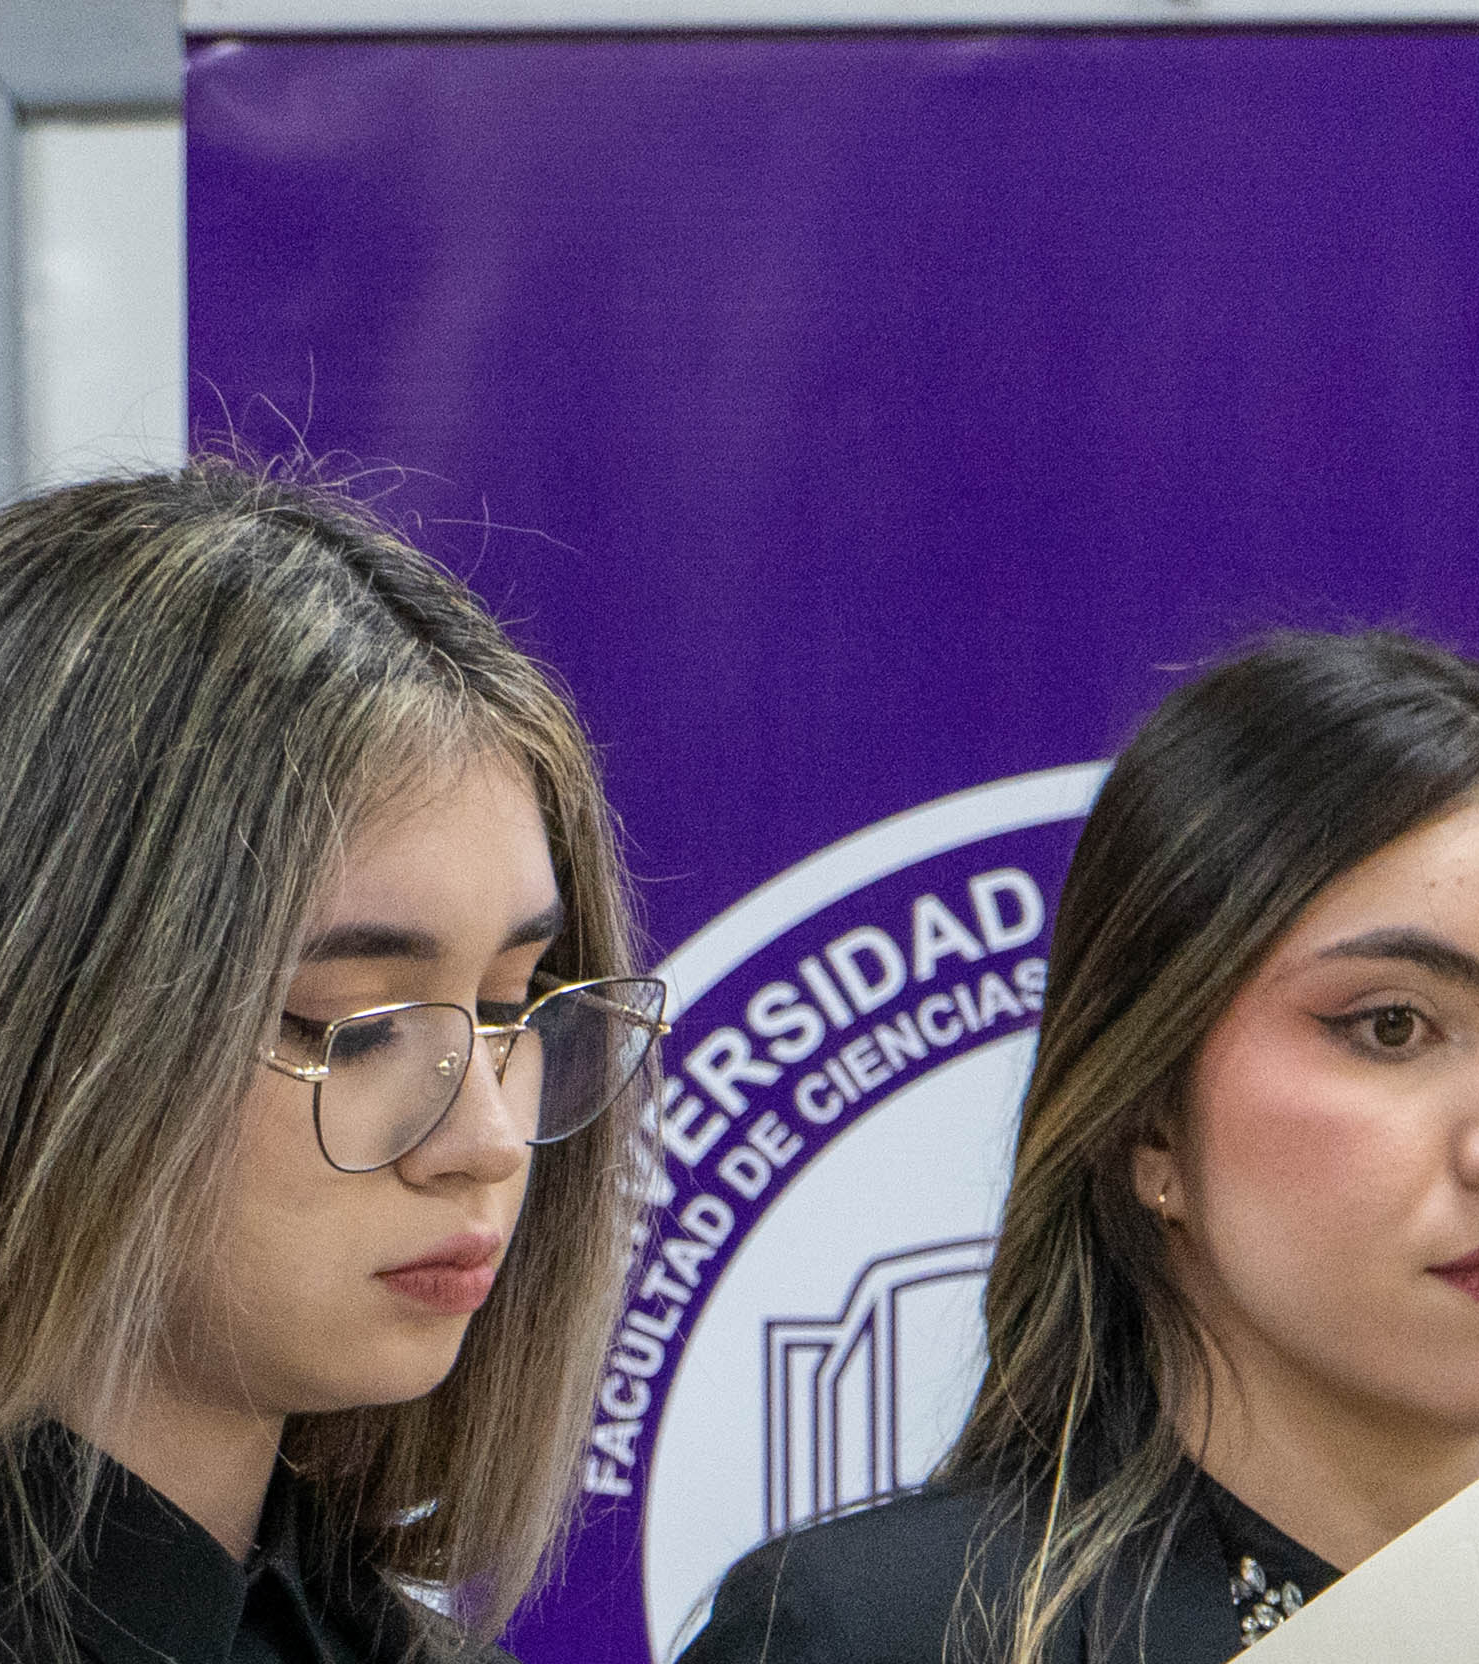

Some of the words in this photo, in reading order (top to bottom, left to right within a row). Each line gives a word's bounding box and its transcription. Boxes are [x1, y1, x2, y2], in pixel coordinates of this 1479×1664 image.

[583, 1193, 735, 1498] FACULTAD
[717, 1109, 806, 1202] DE
[793, 957, 1049, 1125] CIENCIAS
